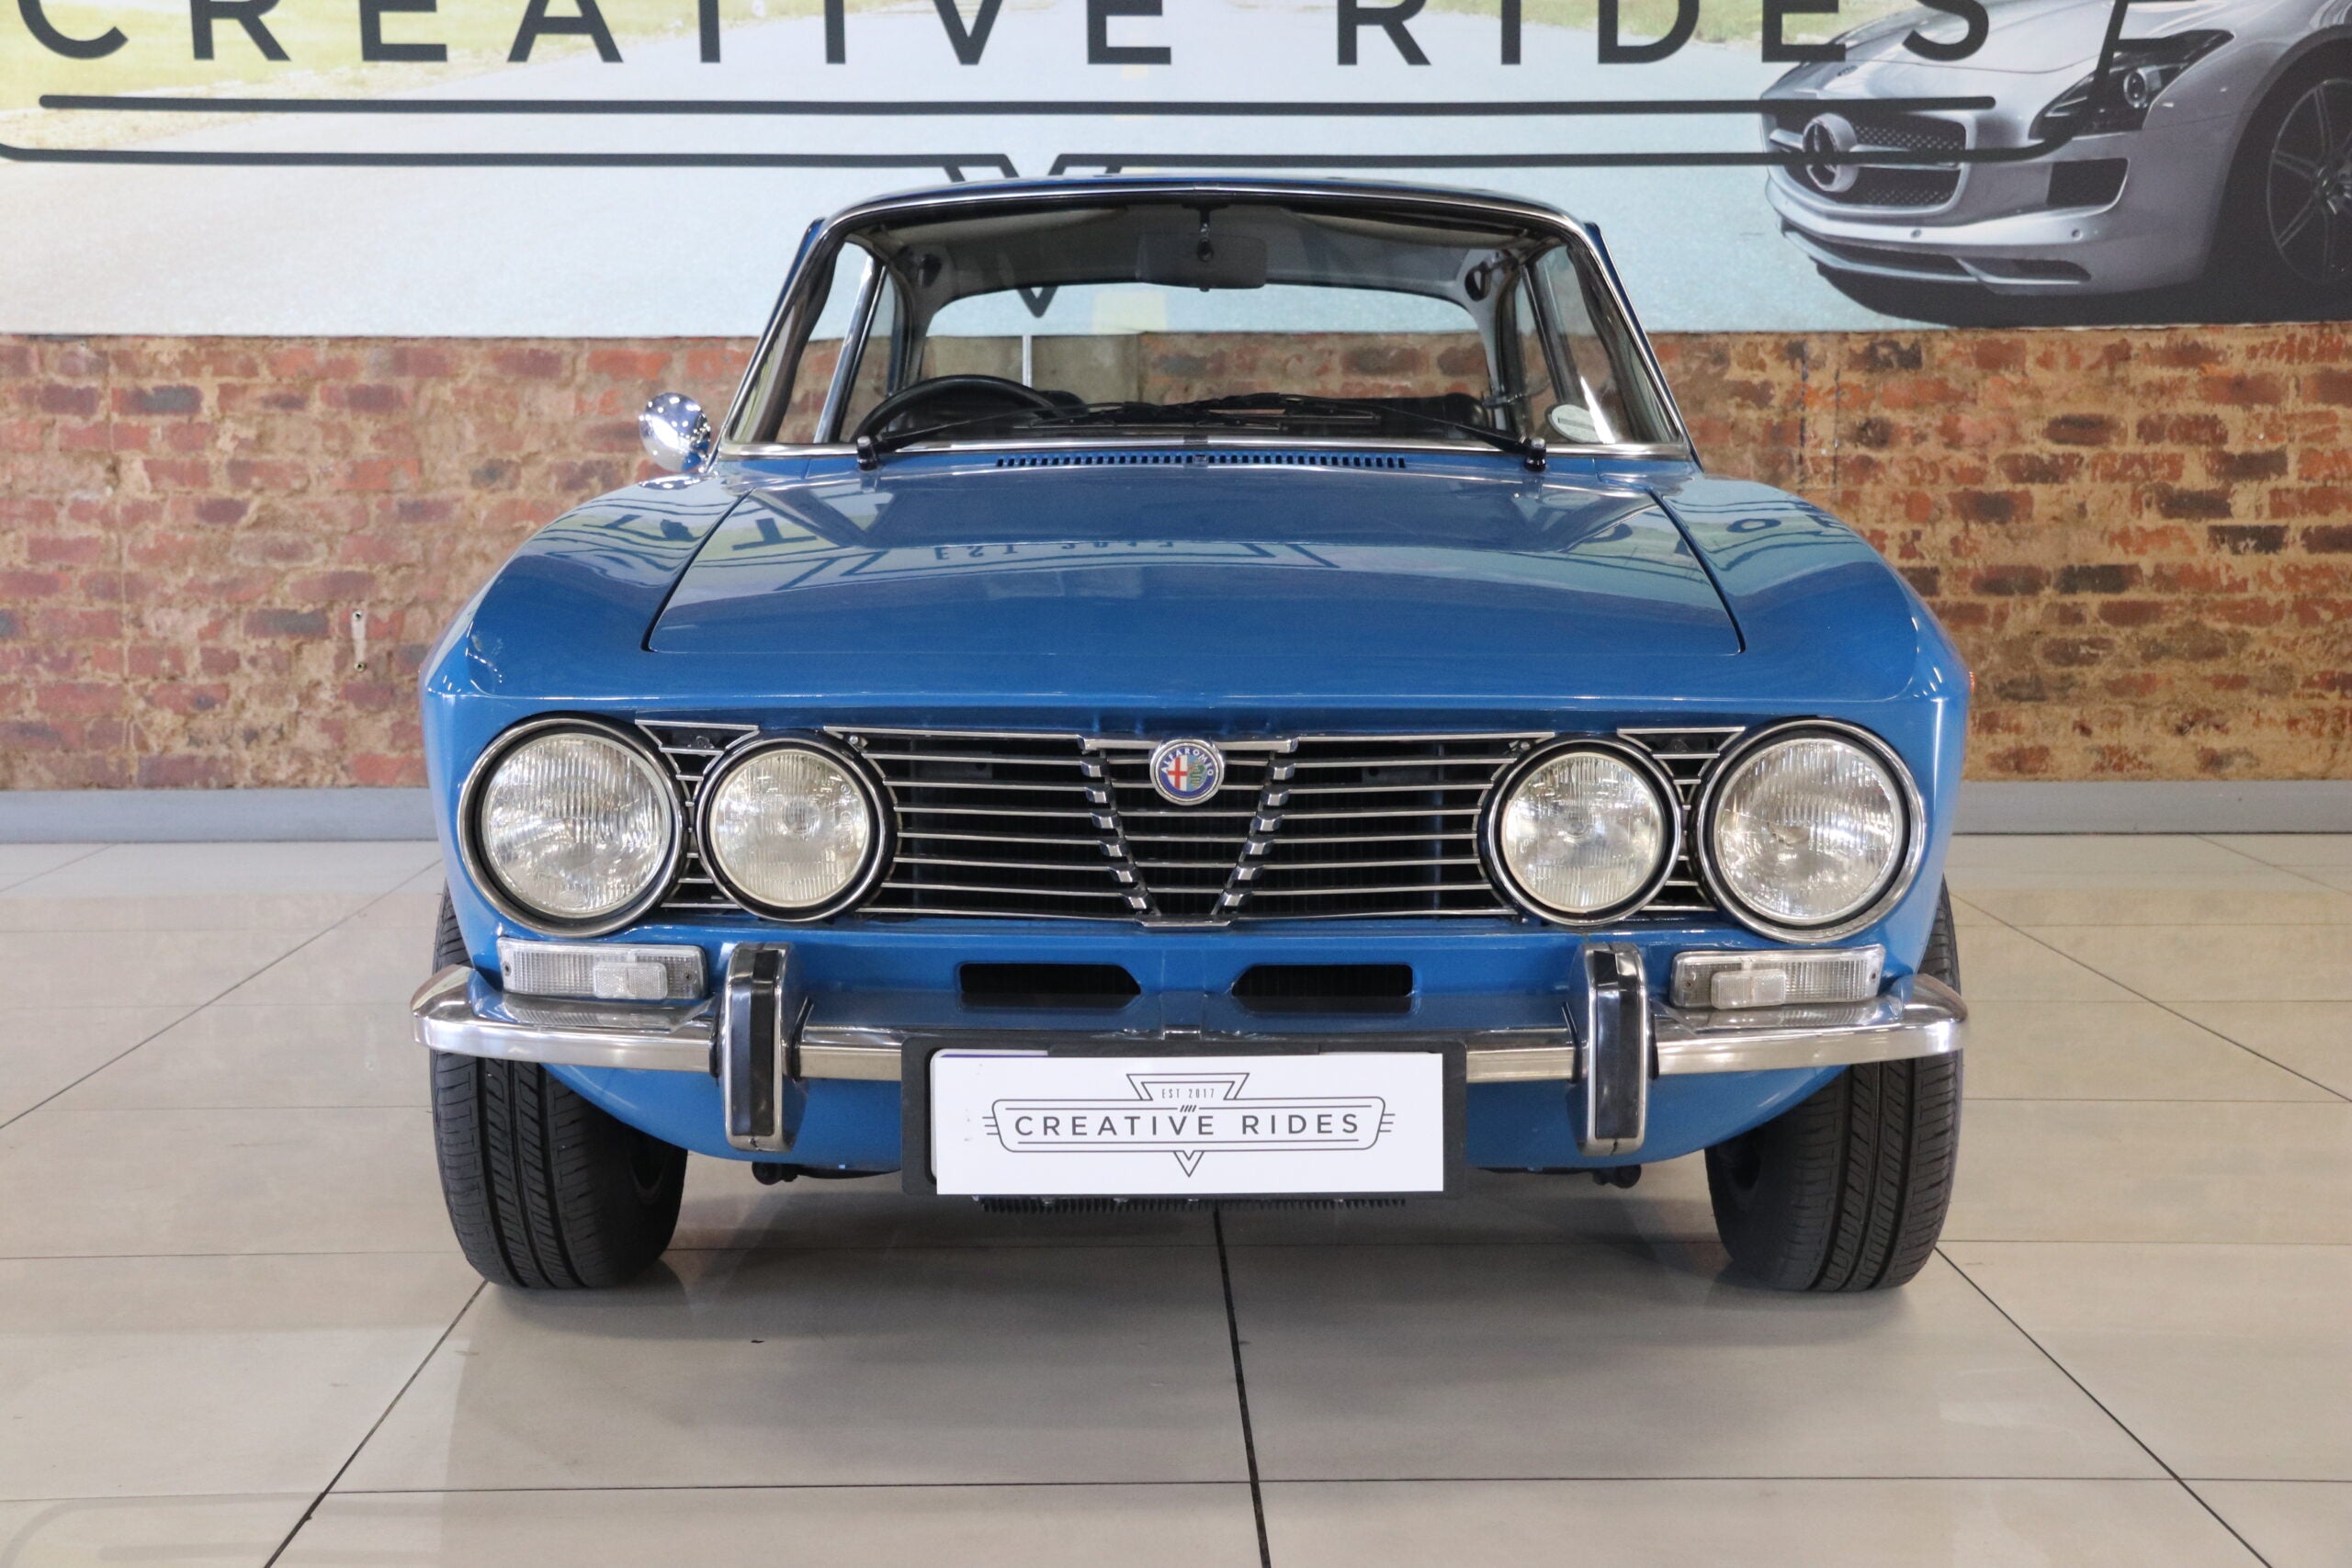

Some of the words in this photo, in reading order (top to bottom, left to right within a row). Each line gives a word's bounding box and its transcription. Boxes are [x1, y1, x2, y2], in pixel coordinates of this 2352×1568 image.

[1161, 1089, 1181, 1099] EST
[1188, 1088, 1215, 1099] 2017
[1014, 1115, 1214, 1136] CREATIVE
[1243, 1113, 1359, 1134] RIDES
